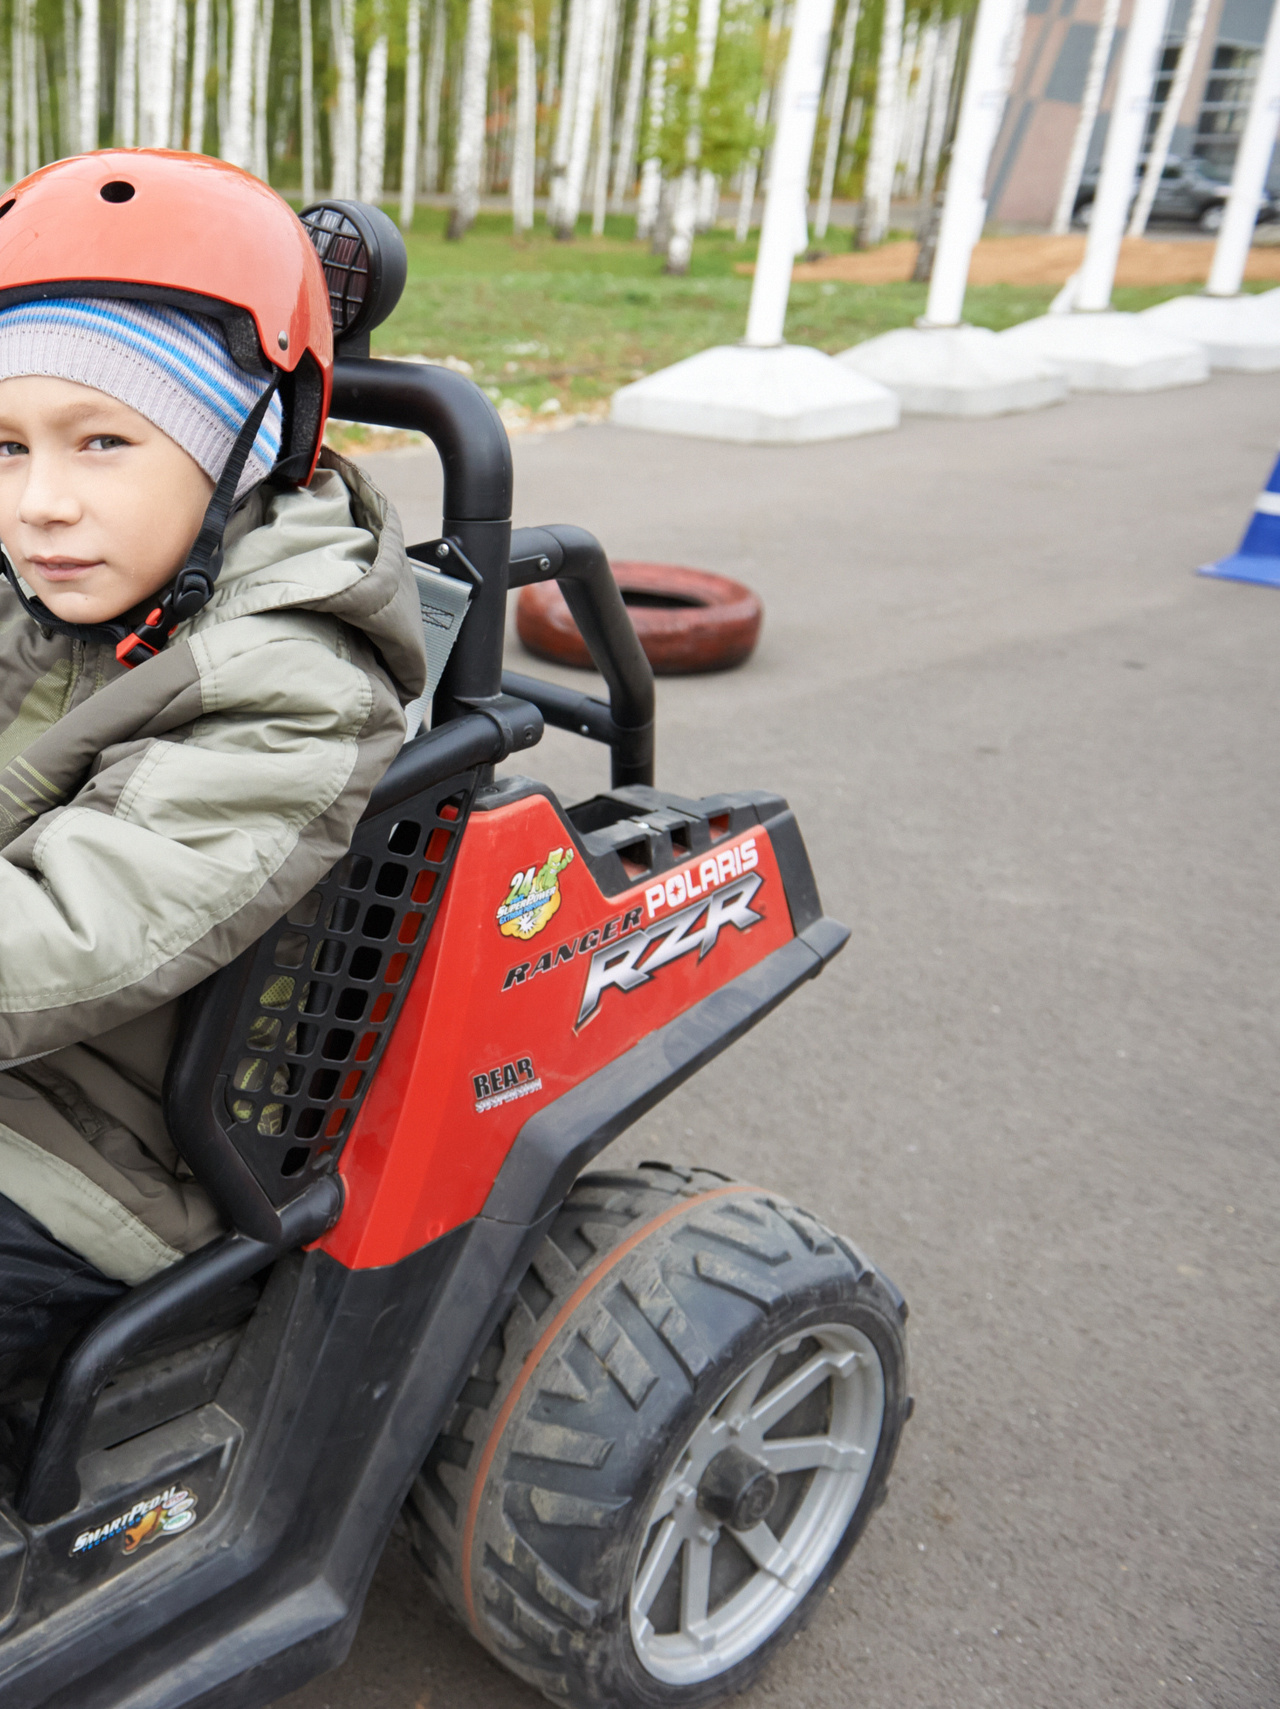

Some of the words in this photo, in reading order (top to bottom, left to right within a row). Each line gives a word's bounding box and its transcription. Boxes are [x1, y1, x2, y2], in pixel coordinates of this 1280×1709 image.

[645, 838, 758, 918] POLARIS
[500, 906, 643, 992] RANGER
[574, 871, 766, 1031] RZR
[473, 1056, 535, 1100] REAR
